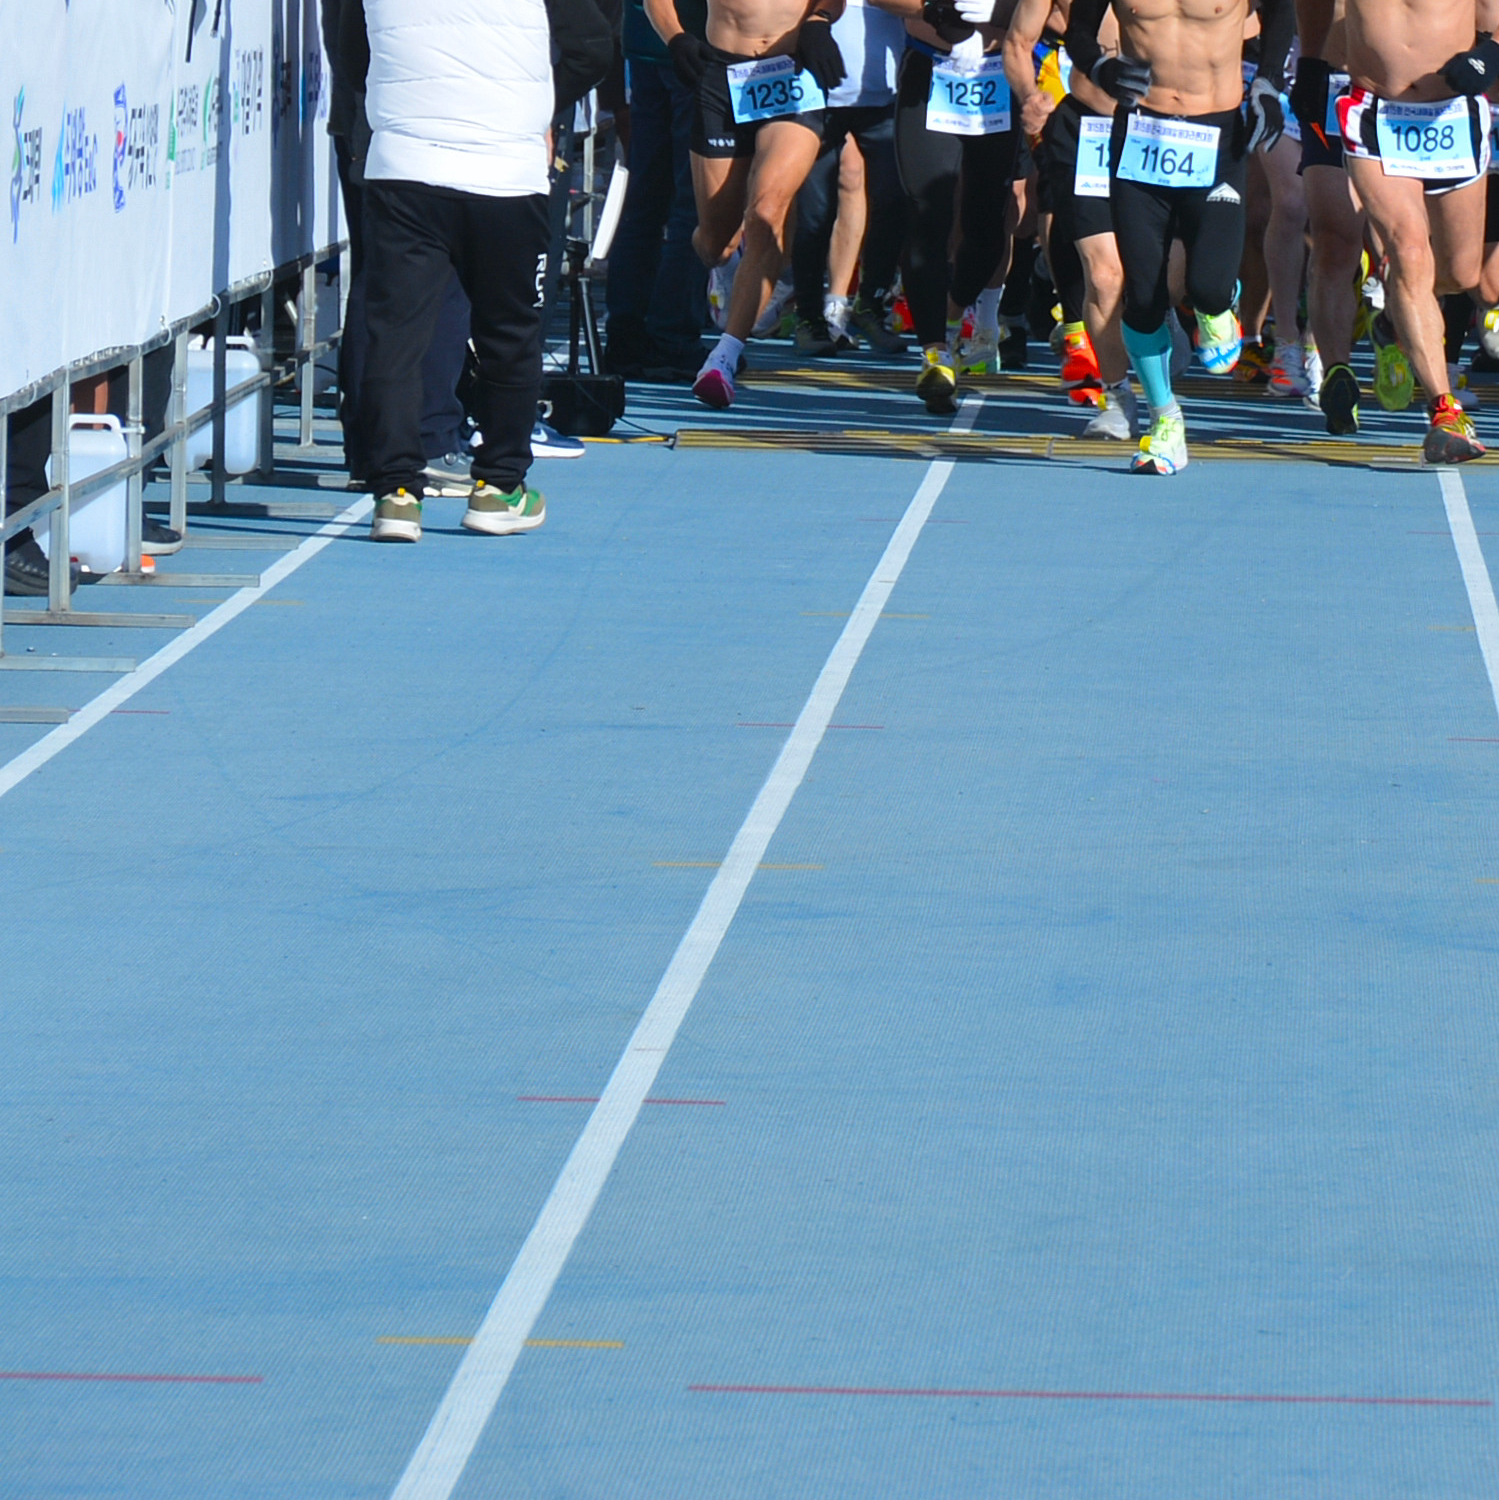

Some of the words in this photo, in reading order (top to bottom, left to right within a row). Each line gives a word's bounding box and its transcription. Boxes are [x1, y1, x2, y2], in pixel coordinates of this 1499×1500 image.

[746, 77, 804, 111] 1235
[945, 80, 998, 107] 1252
[1393, 114, 1455, 153] 1088
[1141, 144, 1195, 177] 1164
